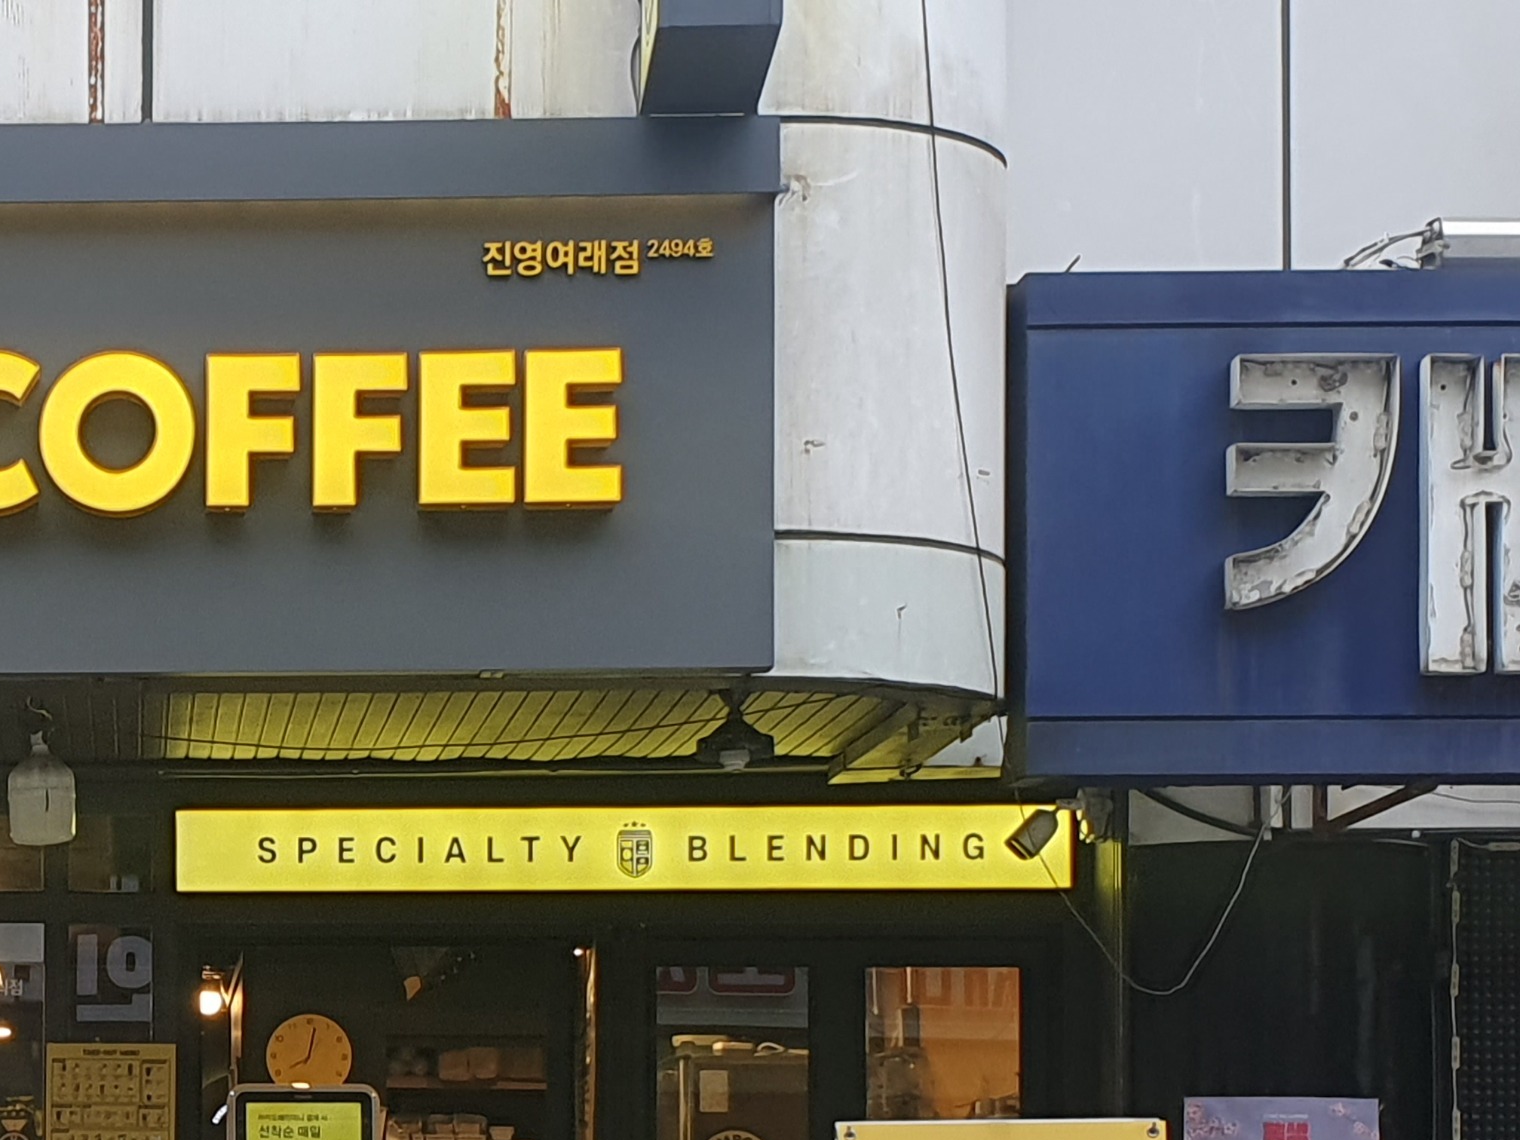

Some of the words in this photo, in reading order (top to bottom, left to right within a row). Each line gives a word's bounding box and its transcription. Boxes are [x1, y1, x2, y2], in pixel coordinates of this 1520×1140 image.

[482, 239, 640, 277] 진영여래점
[647, 237, 715, 258] 2494호
[256, 834, 583, 864] SPECIALTY
[687, 832, 987, 862] BLENDING
[259, 1125, 295, 1139] 선착순
[297, 1125, 321, 1139] 매일
